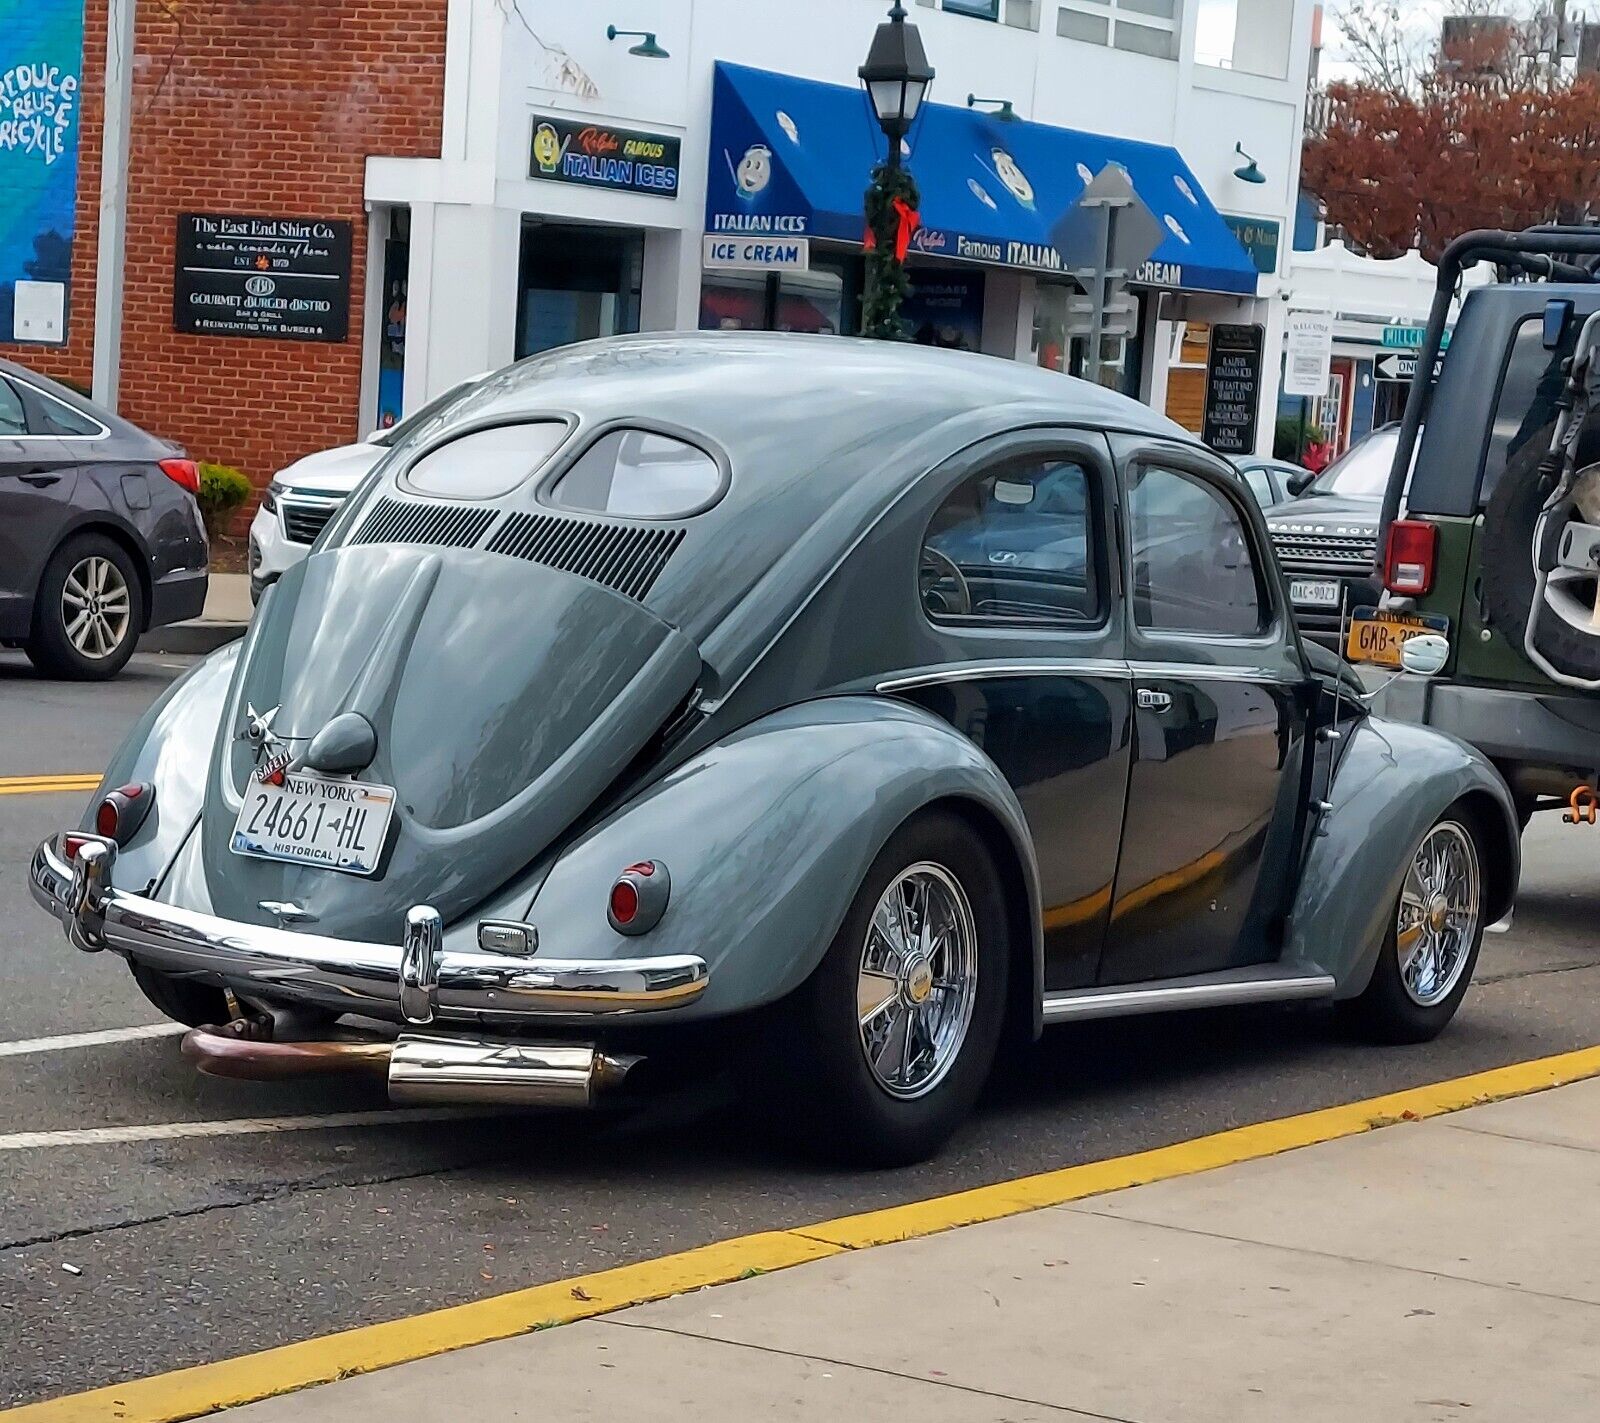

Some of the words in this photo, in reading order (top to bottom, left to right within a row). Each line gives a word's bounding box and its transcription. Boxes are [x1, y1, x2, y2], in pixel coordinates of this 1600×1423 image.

[623, 140, 664, 158] FAMOUS
[563, 152, 632, 185] ITALIAN
[635, 163, 677, 190] ICES
[192, 217, 218, 233] The
[221, 218, 249, 234] East
[251, 220, 277, 236] End
[279, 221, 312, 238] Shirt
[313, 223, 335, 239] Co.
[714, 213, 772, 231] ITALIAN
[775, 215, 807, 232] ICES
[711, 243, 737, 259] ICE
[744, 244, 798, 263] CREAM
[957, 235, 1001, 260] Famous
[1007, 242, 1061, 269] ITALIAN
[1135, 261, 1181, 286] CREAM
[190, 293, 242, 306] GOURMET
[243, 295, 287, 309] BURGER
[289, 298, 331, 312] BISTRO
[1399, 361, 1416, 373] ON
[1268, 523, 1325, 533] RANGE
[1337, 526, 1373, 535] ROV
[257, 747, 294, 780] SAFETY
[285, 779, 317, 796] NEW
[320, 783, 355, 803] YORK
[273, 842, 333, 860] HISTORICAL
